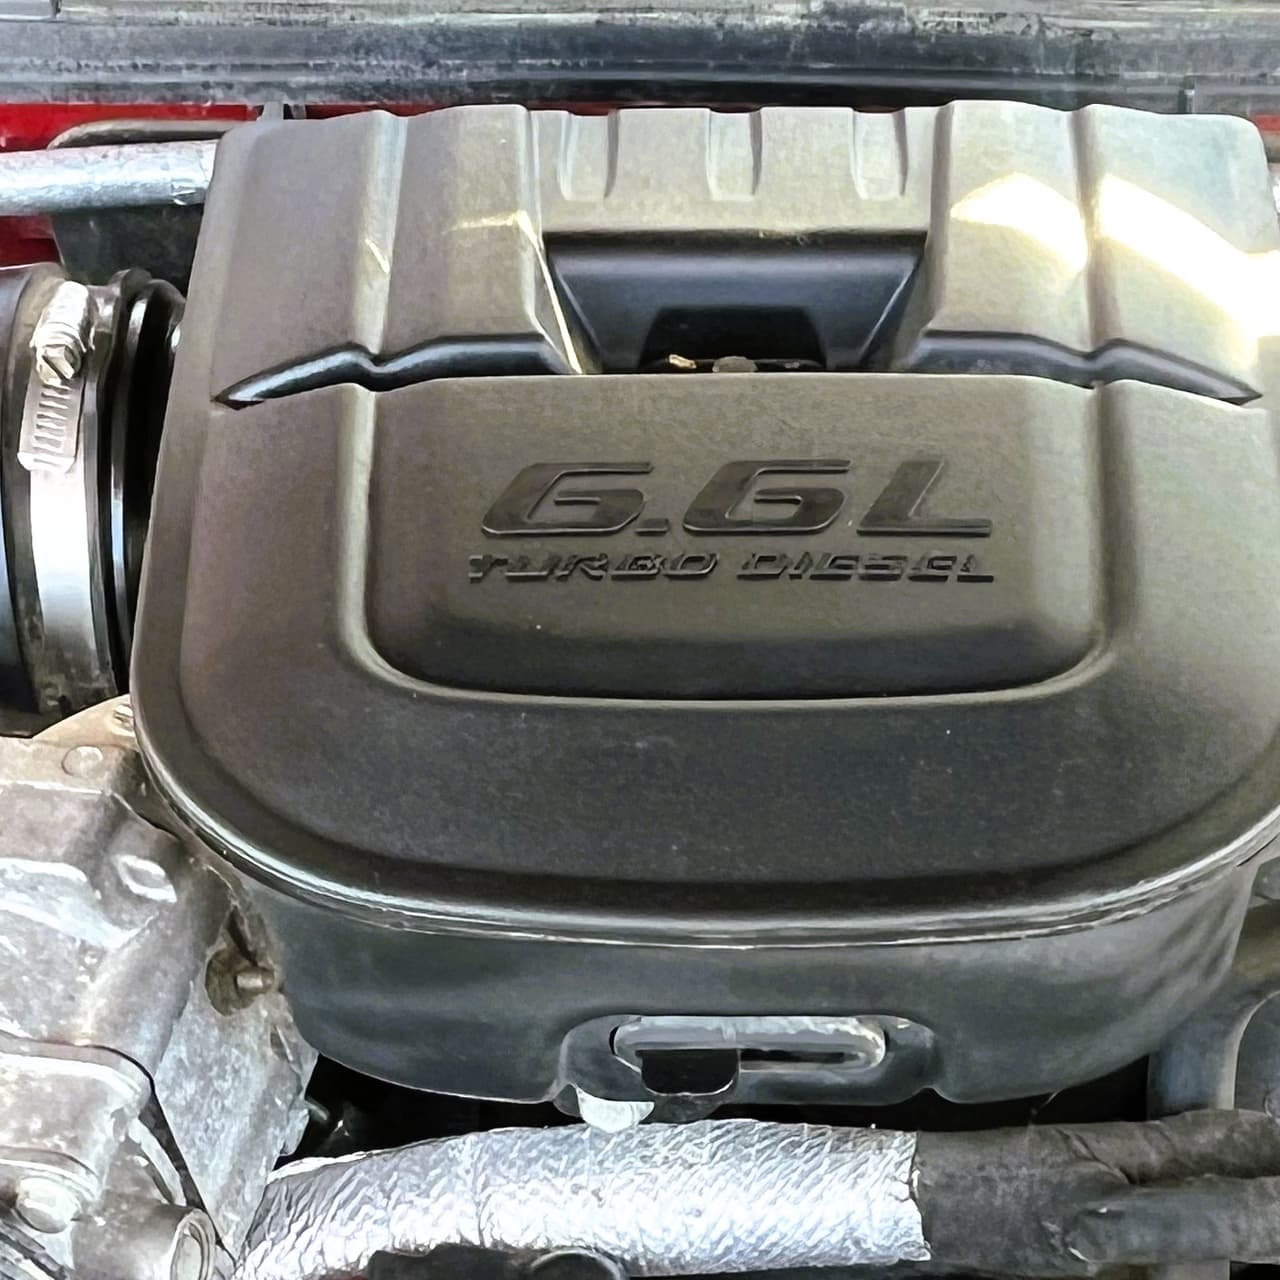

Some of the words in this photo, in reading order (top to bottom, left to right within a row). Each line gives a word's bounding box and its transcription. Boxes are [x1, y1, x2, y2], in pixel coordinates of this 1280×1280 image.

[480, 456, 993, 538] 6.6L
[467, 552, 720, 583] TURBO
[735, 552, 996, 583] DIESEL
